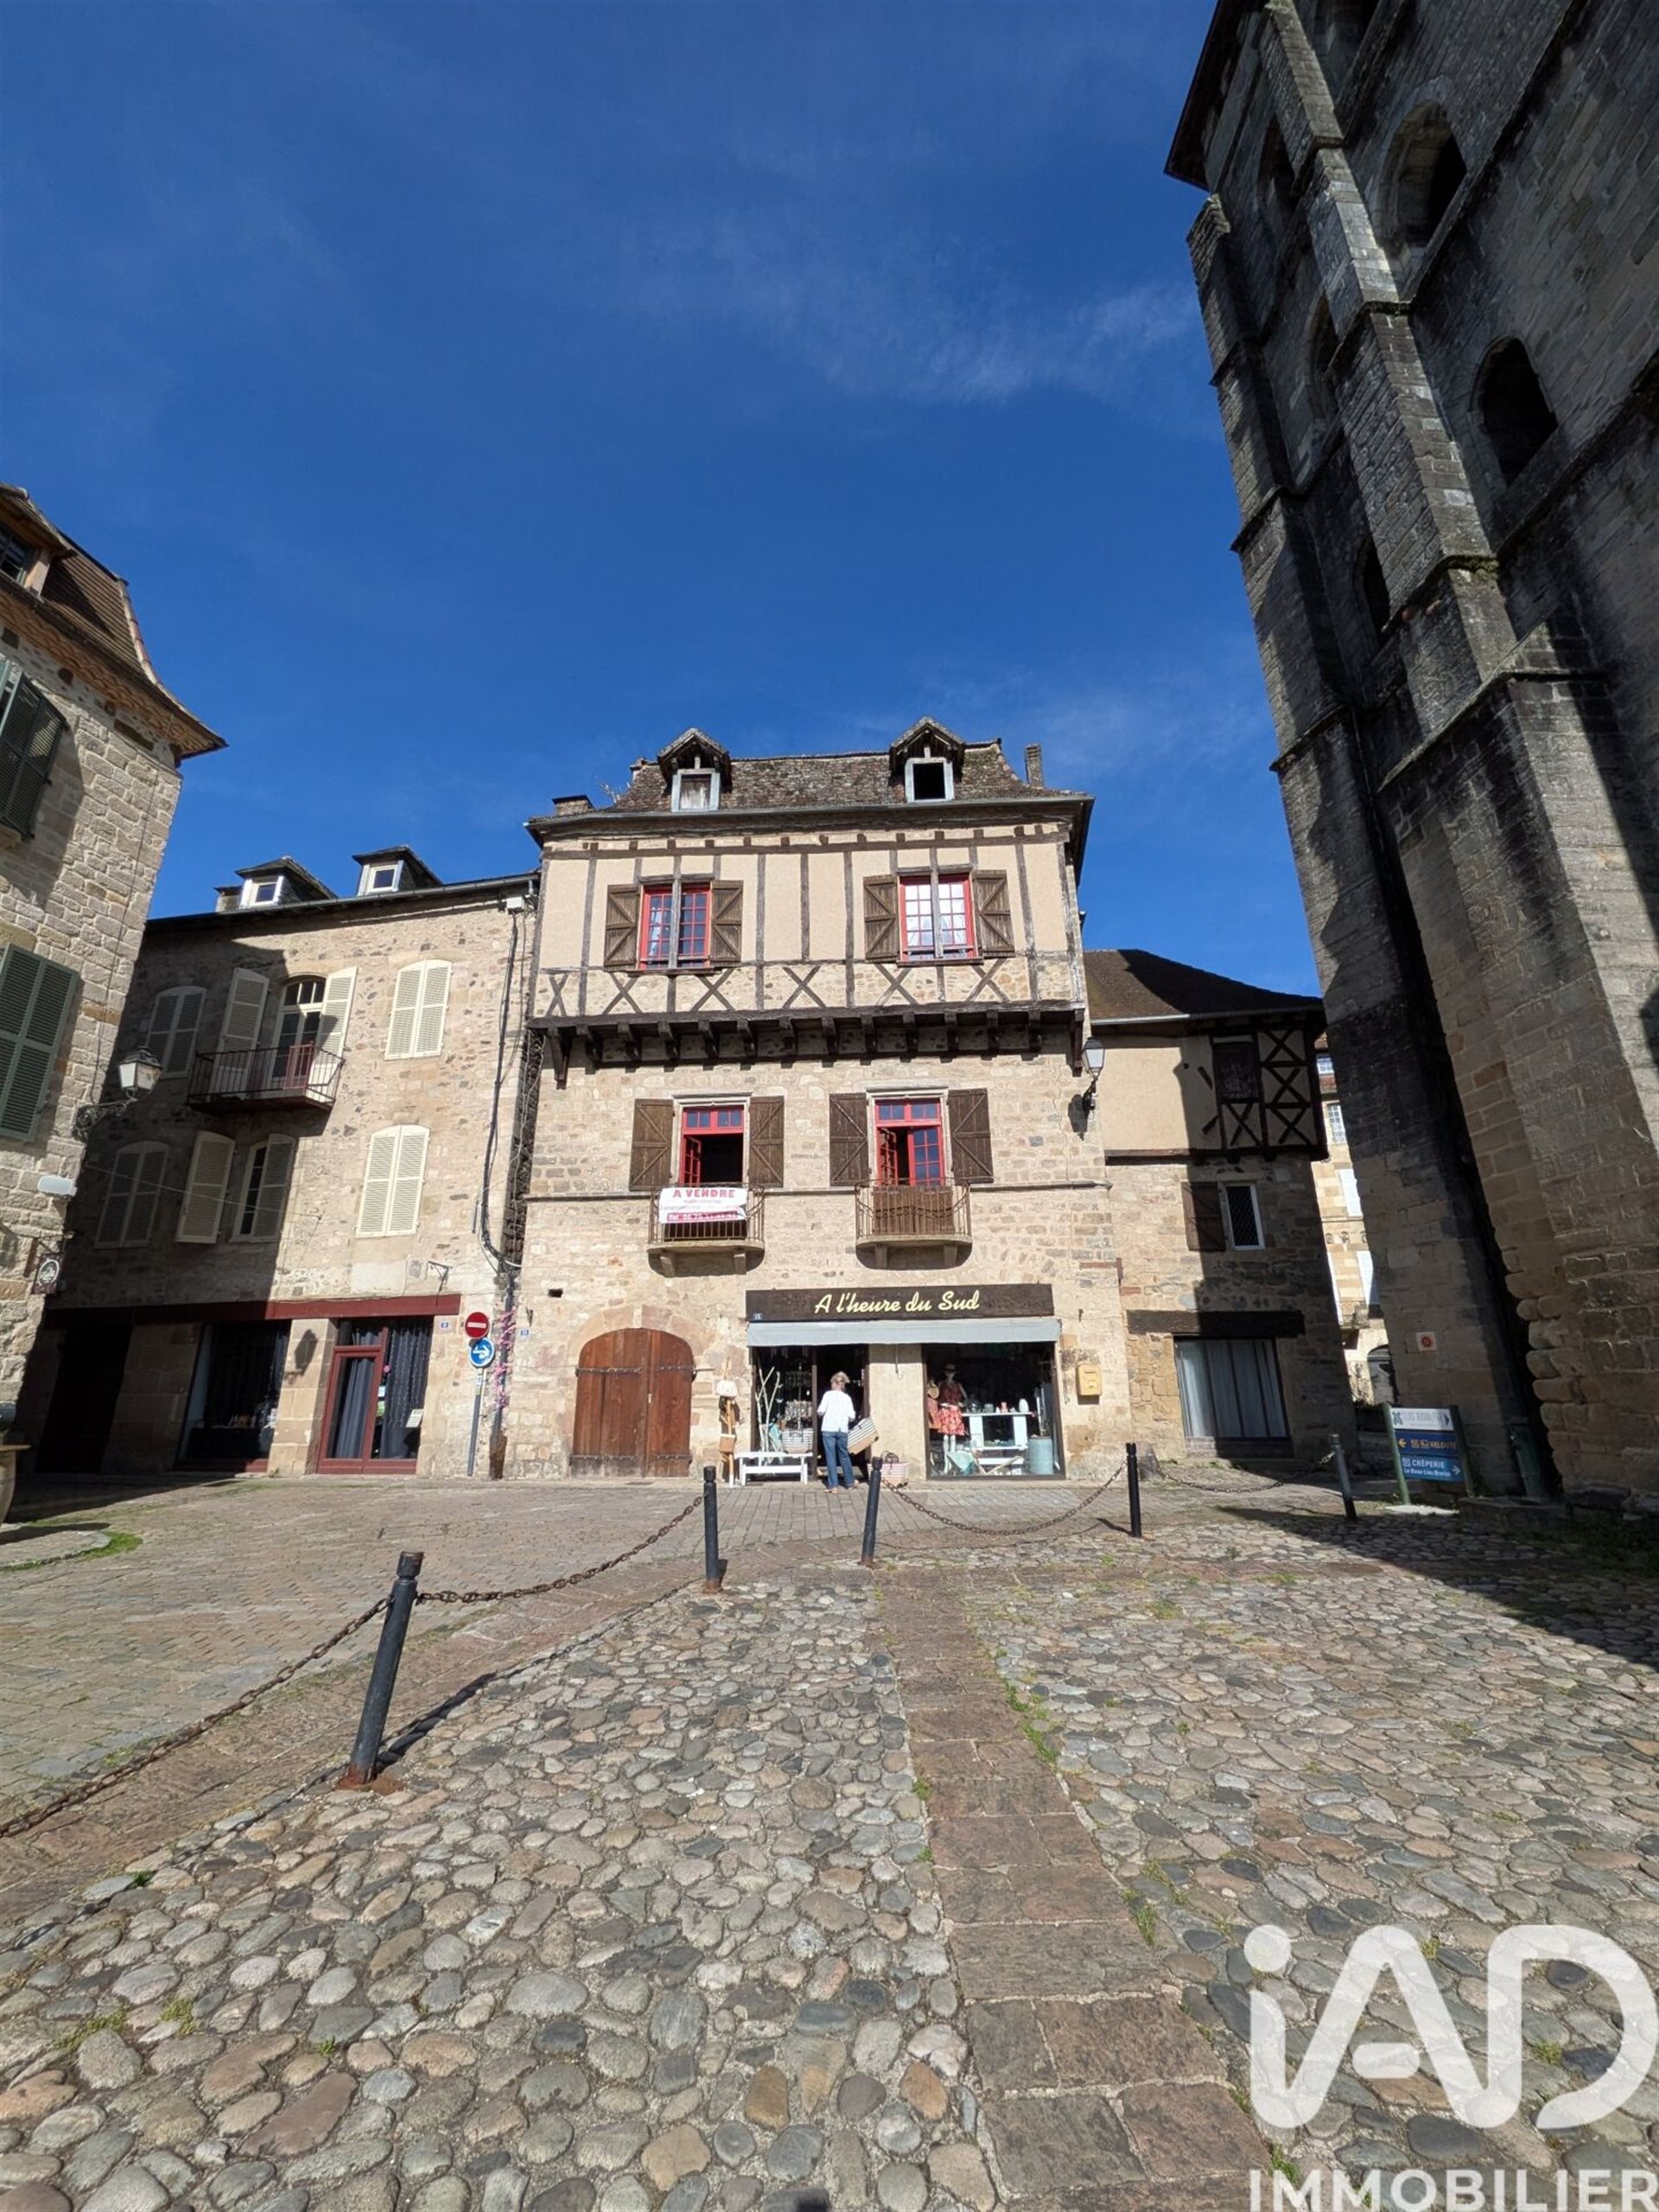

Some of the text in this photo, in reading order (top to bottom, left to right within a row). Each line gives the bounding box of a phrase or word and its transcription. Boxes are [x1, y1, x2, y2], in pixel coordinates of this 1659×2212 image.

[673, 1189, 735, 1198] A VENDRE
[814, 1289, 980, 1313] A l'heure du Sud
